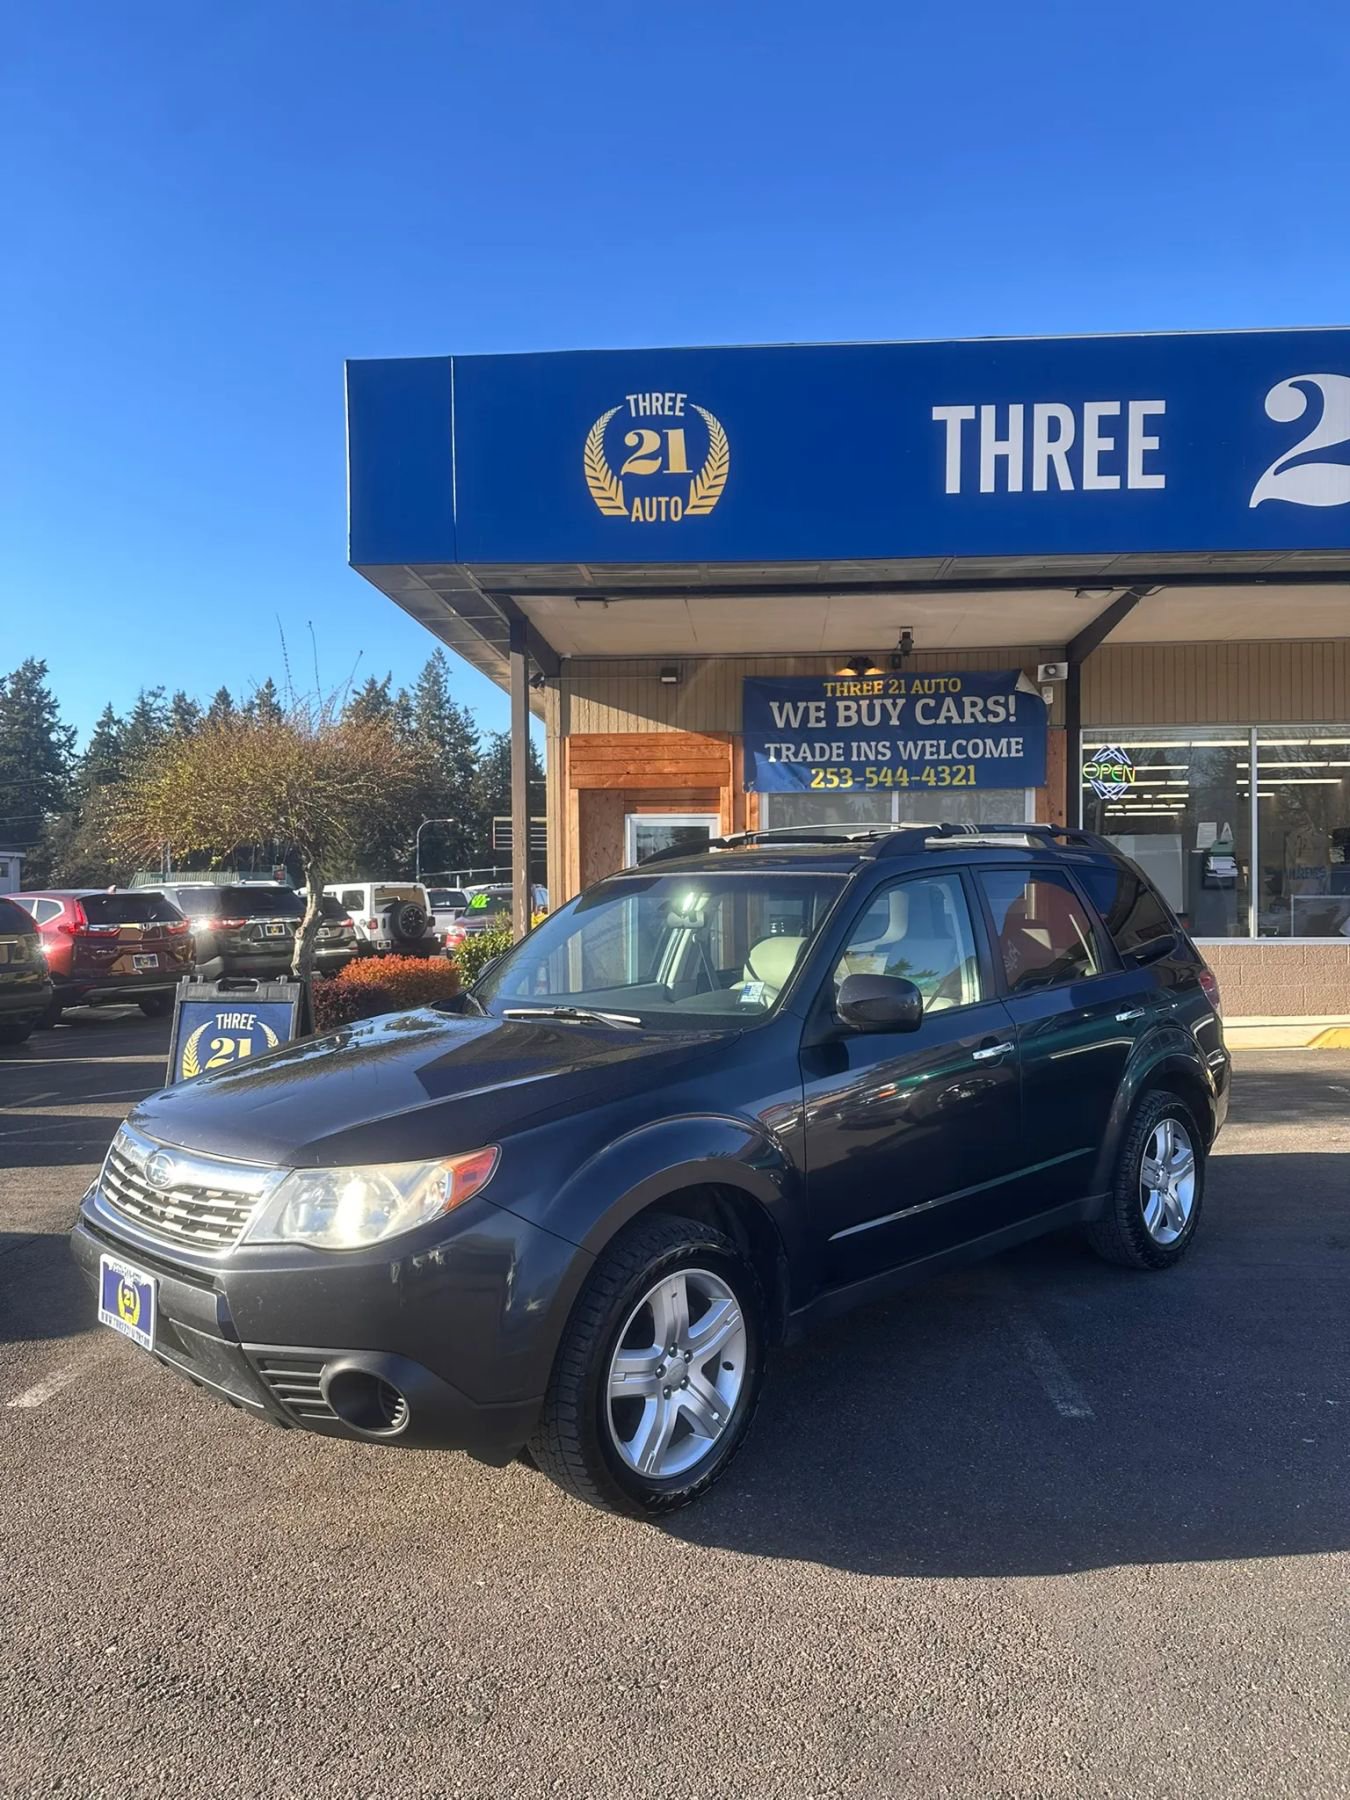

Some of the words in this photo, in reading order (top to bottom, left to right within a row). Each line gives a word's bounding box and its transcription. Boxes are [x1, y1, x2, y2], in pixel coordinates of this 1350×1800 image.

[625, 392, 688, 418] THREE
[620, 428, 694, 476] 21
[931, 400, 1166, 494] THREE
[631, 496, 683, 522] AUTO
[823, 679, 885, 697] THREE
[888, 679, 906, 695] 21
[911, 677, 961, 695] AUTO
[769, 701, 827, 728] WE
[836, 699, 909, 727] BUY
[915, 695, 1017, 725] CARS!
[765, 743, 845, 763] TRADE
[851, 742, 892, 761] INS
[897, 737, 1024, 760] WELCOME
[810, 765, 977, 788] 253-544-4321
[1082, 761, 1136, 784] OPEN
[215, 1012, 257, 1030] THREE
